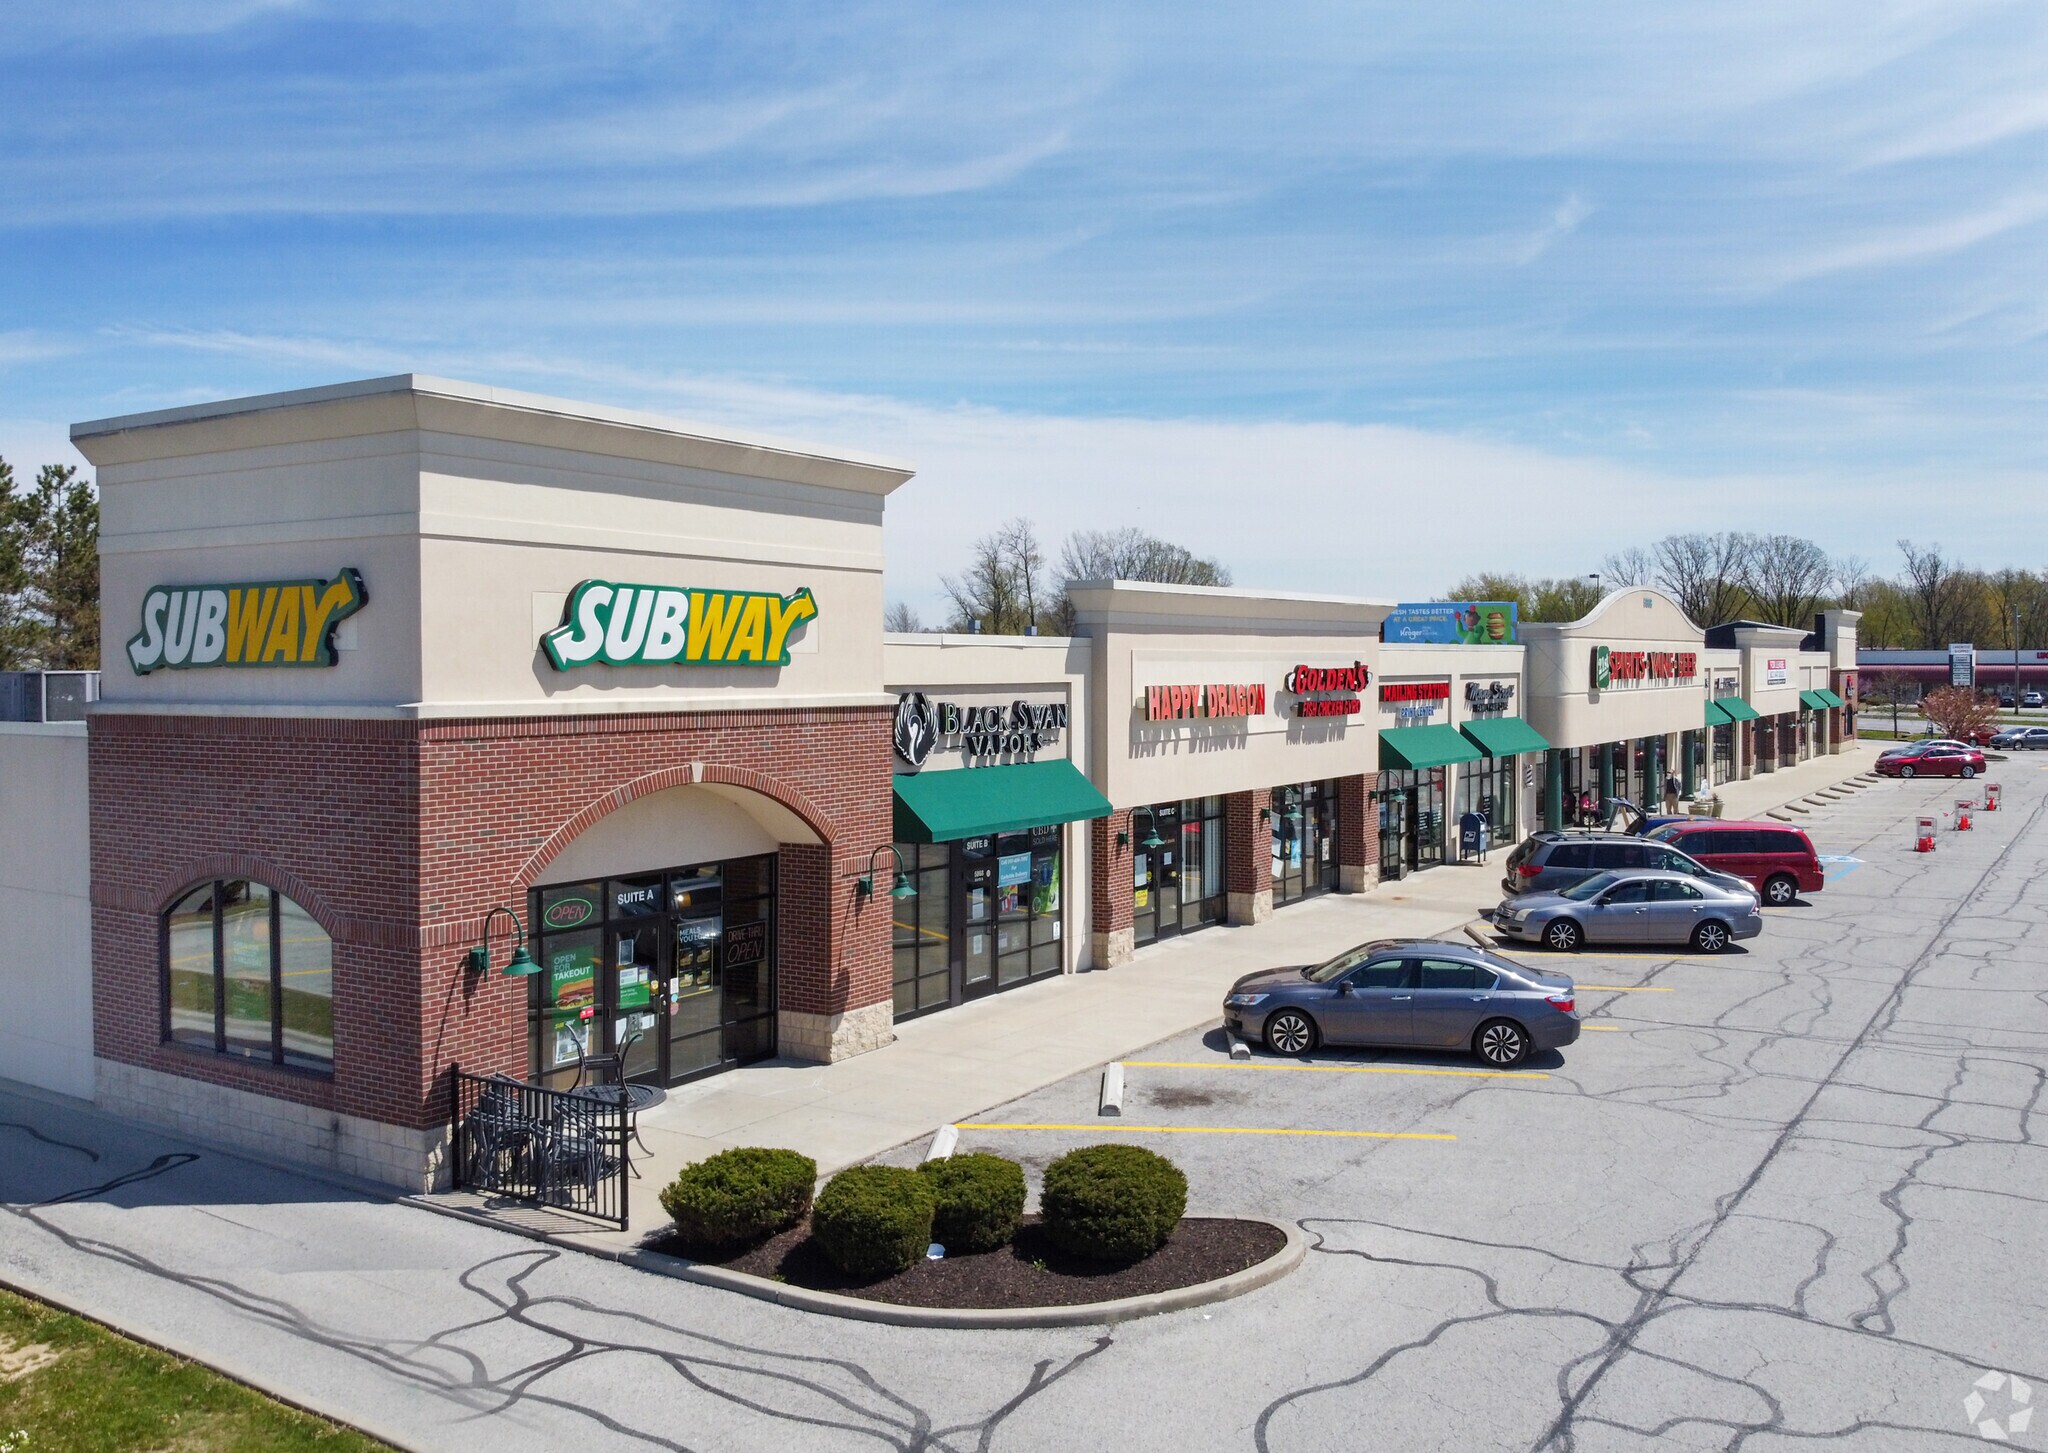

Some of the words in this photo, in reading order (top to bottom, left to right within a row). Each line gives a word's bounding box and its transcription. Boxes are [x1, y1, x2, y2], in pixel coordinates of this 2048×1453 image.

[129, 576, 353, 670] SUBWAY
[552, 586, 816, 666] SUBWAY
[1400, 626, 1422, 640] Kroger
[1610, 651, 1645, 680] SPIRITS
[1651, 651, 1674, 680] WINE
[1678, 652, 1697, 678] BEER
[1296, 661, 1368, 695] GOLDEN'S
[1383, 683, 1417, 702] MAILING
[1419, 682, 1449, 699] STATION
[1149, 684, 1200, 721] HAPPY
[1207, 684, 1265, 718] DRAGON
[1303, 700, 1317, 717] FISH
[1318, 700, 1343, 717] CHICKEN
[944, 702, 1011, 735] BLACK
[1018, 701, 1068, 731] SWAN
[970, 733, 1044, 756] VAPORS
[966, 840, 983, 850] SUITE
[1032, 837, 1046, 846] SOLD
[617, 890, 645, 905] SUITE
[646, 889, 654, 900] A
[550, 905, 586, 920] OPEN
[680, 927, 701, 936] MEALS
[553, 953, 577, 965] OPEN
[727, 940, 763, 963] OPEN
[553, 963, 571, 973] FOR
[553, 966, 591, 981] TAKEOUT
